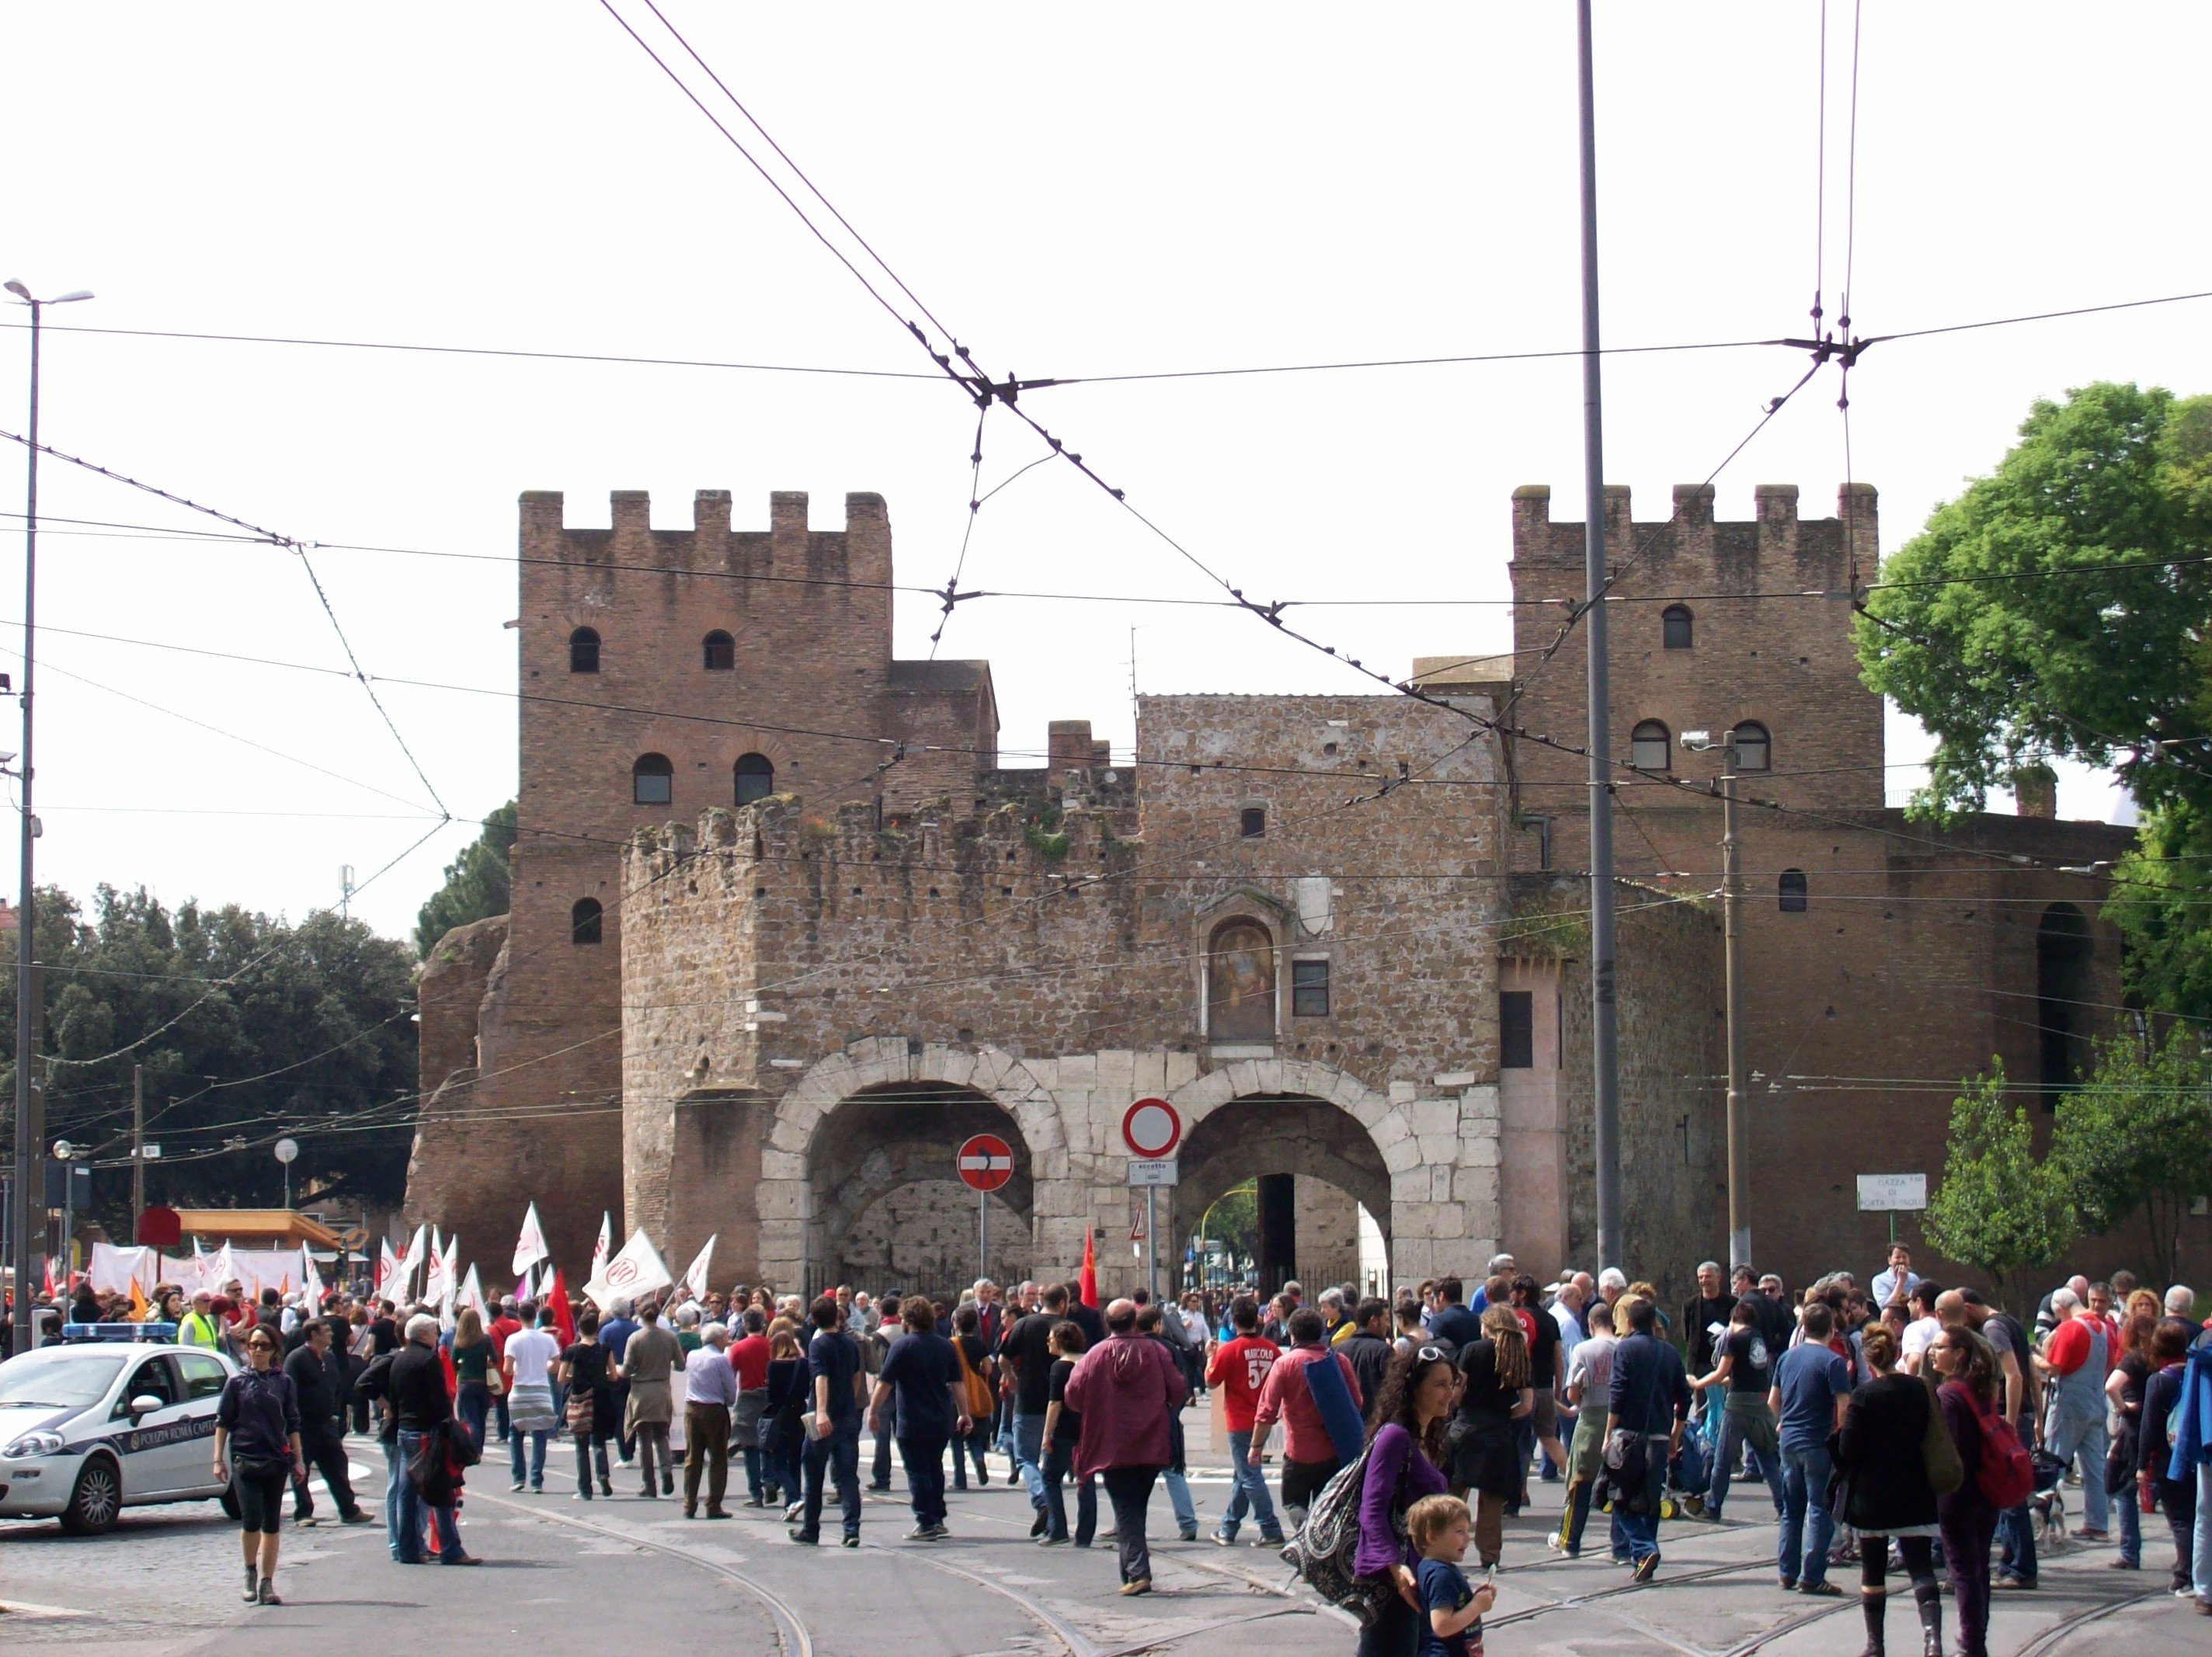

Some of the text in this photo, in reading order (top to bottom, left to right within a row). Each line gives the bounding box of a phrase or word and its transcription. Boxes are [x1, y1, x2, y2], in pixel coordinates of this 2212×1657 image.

[1247, 1359, 1273, 1390] 57
[141, 1429, 169, 1446] POLIZIA
[170, 1424, 192, 1441] ROMA
